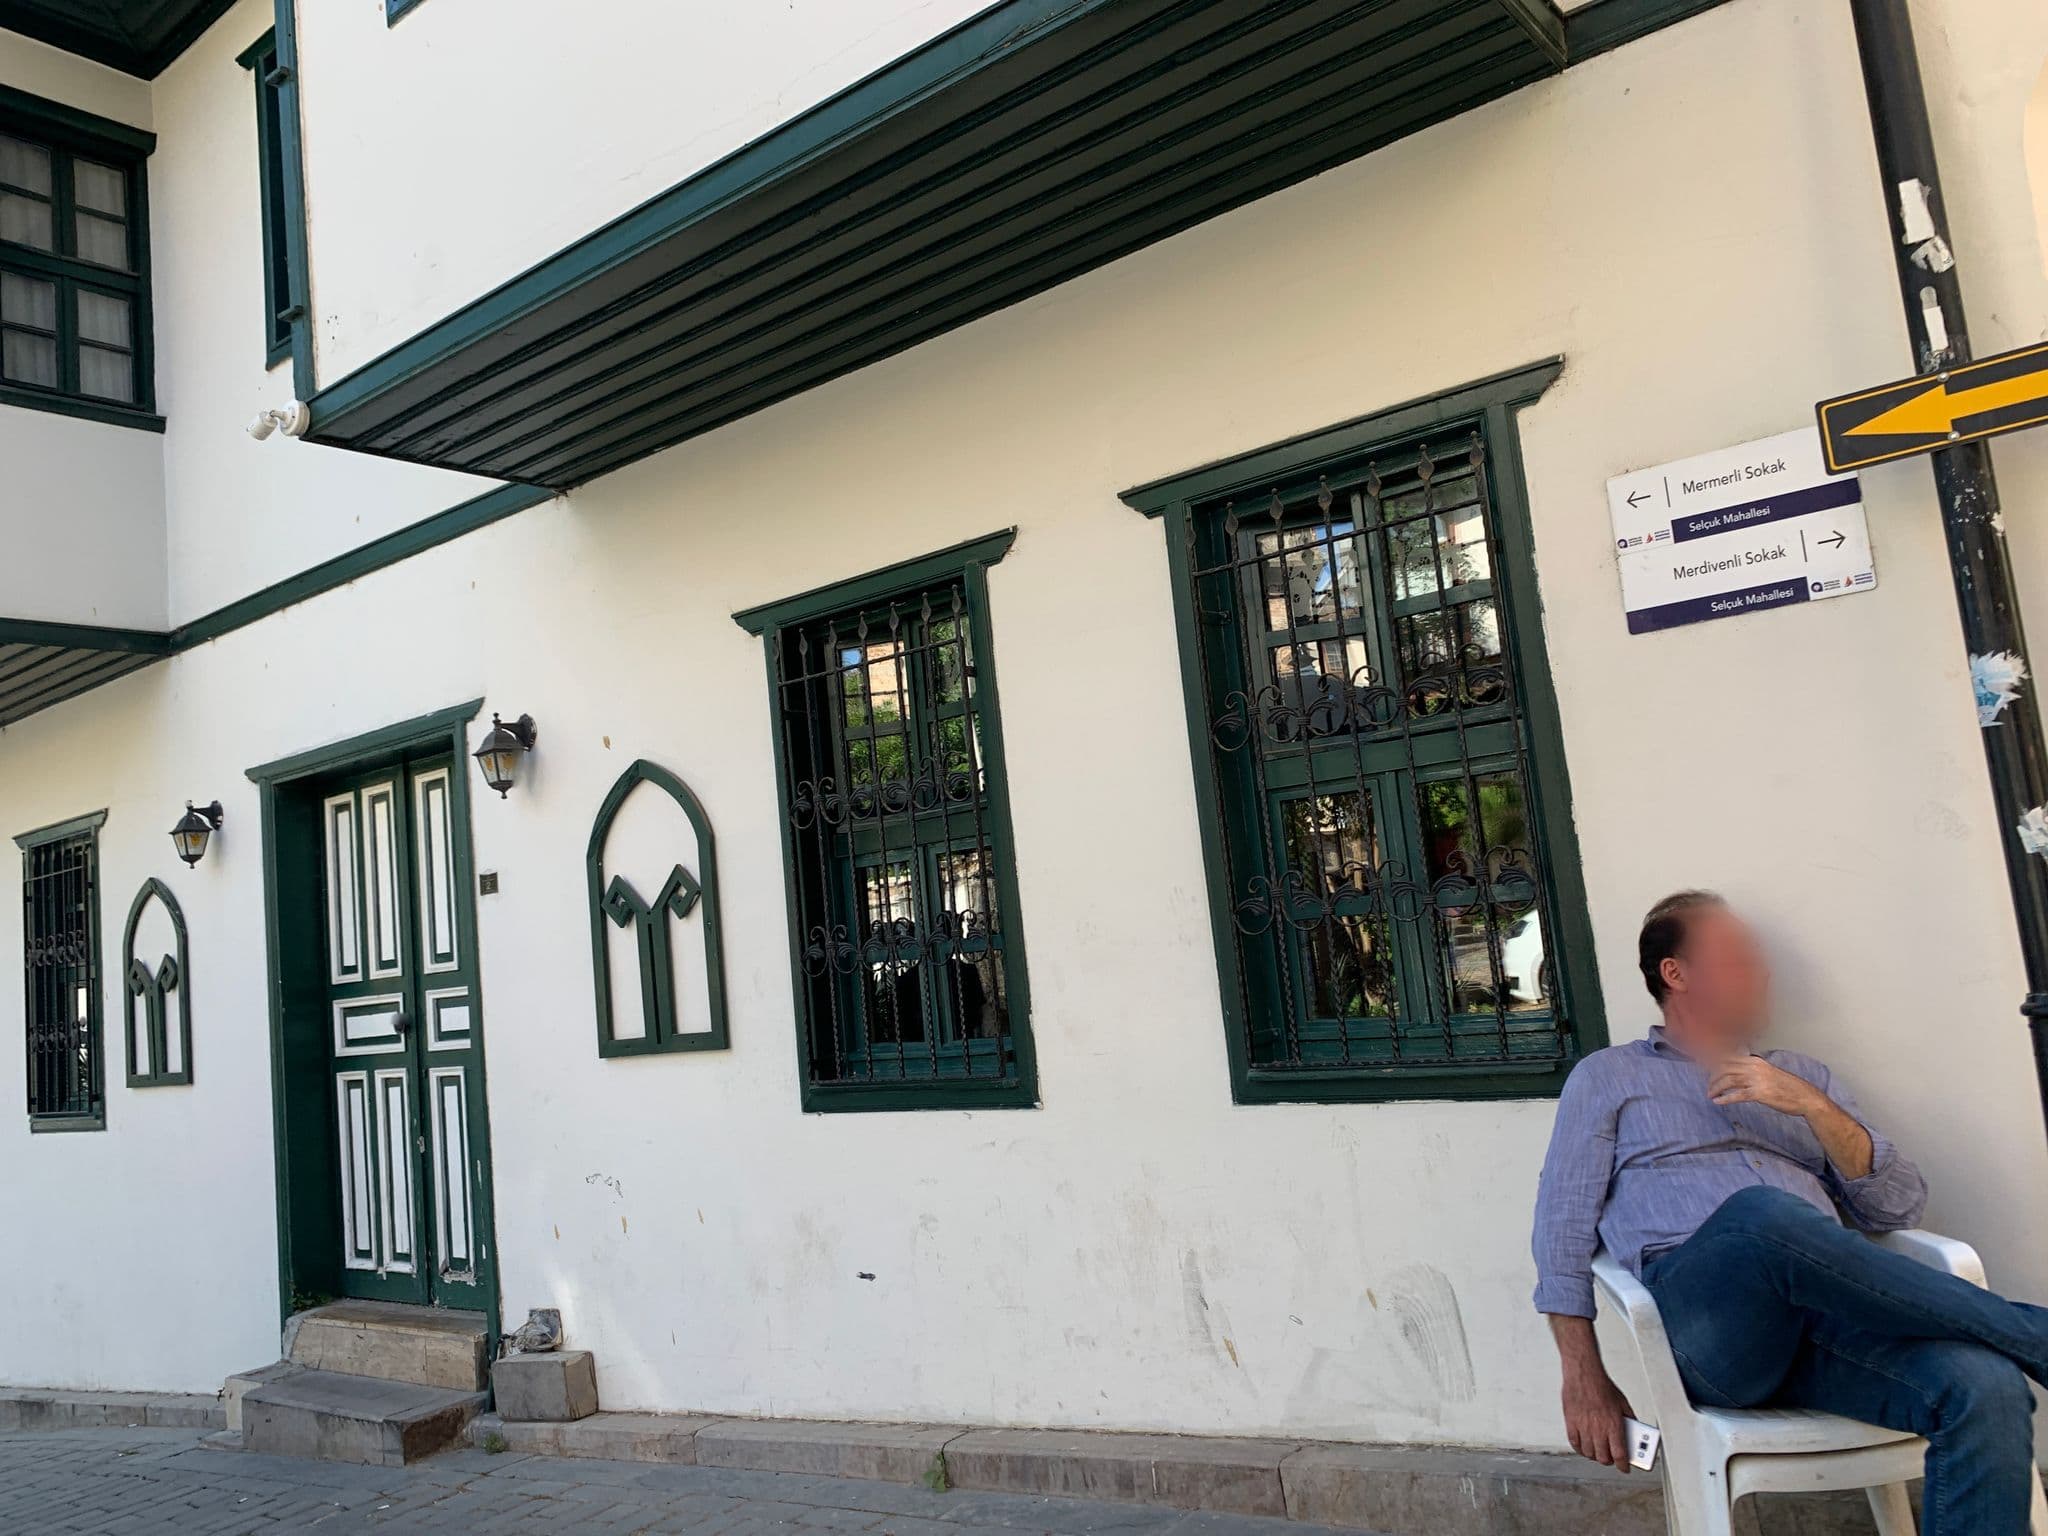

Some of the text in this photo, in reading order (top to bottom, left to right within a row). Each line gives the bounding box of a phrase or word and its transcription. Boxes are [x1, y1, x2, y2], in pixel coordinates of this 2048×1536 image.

[1683, 459, 1786, 495] Mermerli Sokak
[1689, 506, 1771, 533] Selçuk Mahallesi
[1673, 545, 1786, 580] Merdivenli Sokak
[1711, 588, 1794, 612] Selçuk Mahallesi
